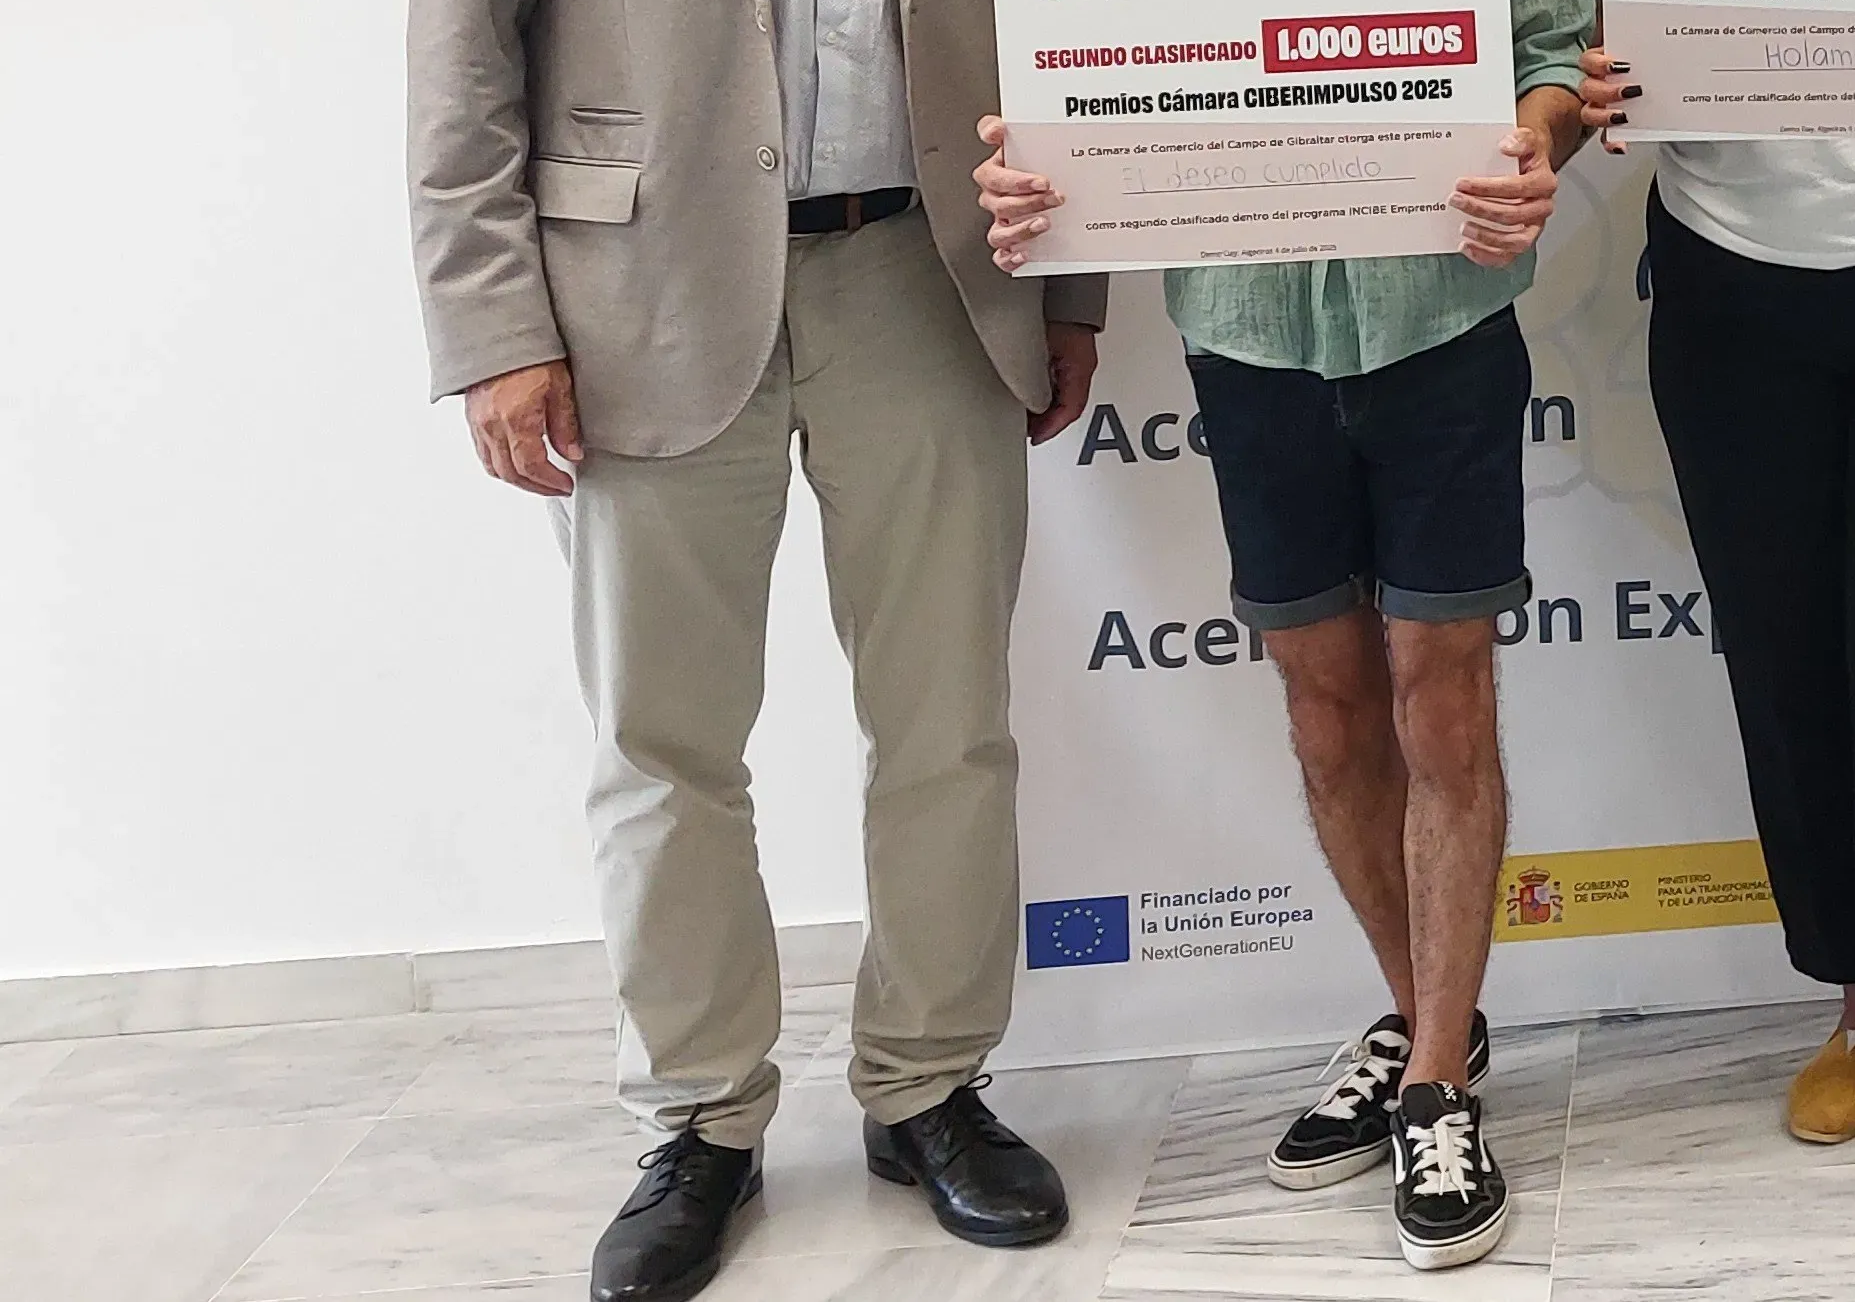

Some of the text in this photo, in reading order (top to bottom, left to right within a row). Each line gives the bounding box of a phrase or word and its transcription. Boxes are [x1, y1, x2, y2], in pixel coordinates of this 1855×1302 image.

[1665, 26, 1678, 35] La
[1722, 26, 1736, 35] de
[1790, 25, 1806, 34] del
[1809, 25, 1845, 35] Campo
[1034, 23, 1464, 70] SEGUNDO CLASIFICADO 1.000 euros
[1065, 78, 1453, 118] Premios Cámara CIBERIMPULSO 2025
[1071, 148, 1085, 157] La
[1133, 144, 1148, 154] de
[1150, 142, 1204, 154] Comercio
[1206, 140, 1224, 150] del
[1227, 139, 1267, 151] Campo
[1269, 137, 1284, 147] de
[1286, 134, 1335, 146] Gibraltar
[1377, 131, 1401, 142] este
[1403, 129, 1443, 142] premio
[1445, 131, 1452, 139] a
[1085, 202, 1446, 230] como segundo clasificado dentro del programa INCIBE Emprende
[1140, 883, 1292, 909] Financiado por
[1573, 879, 1630, 892] GOBIERNO
[1574, 893, 1589, 903] DE
[1684, 885, 1697, 895] LA
[1140, 907, 1314, 934] la Unión Europea
[1141, 934, 1294, 962] NextGenerationEU
